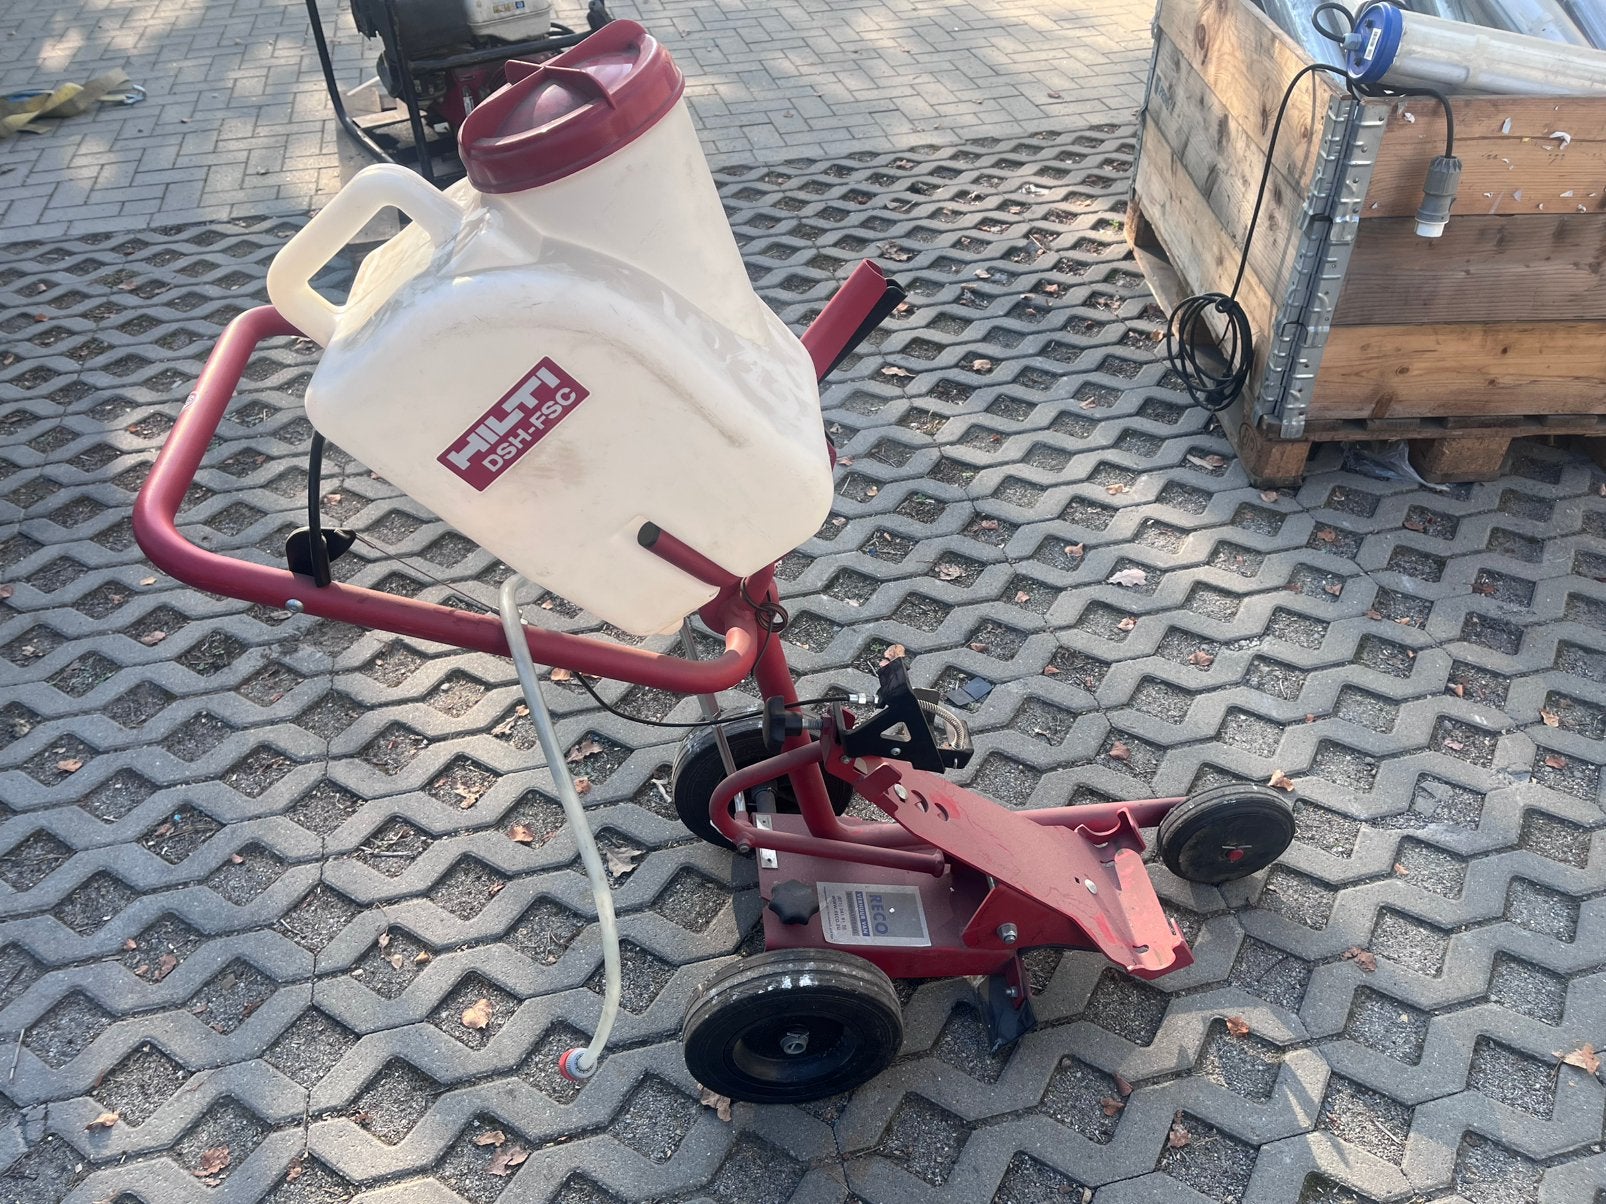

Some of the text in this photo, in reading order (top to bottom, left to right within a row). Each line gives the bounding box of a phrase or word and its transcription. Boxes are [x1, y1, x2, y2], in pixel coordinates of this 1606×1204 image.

[446, 367, 561, 471] HILTI
[481, 387, 577, 472] DSH-FSC
[856, 892, 865, 920] VERHUUR
[869, 895, 888, 934] RECO
